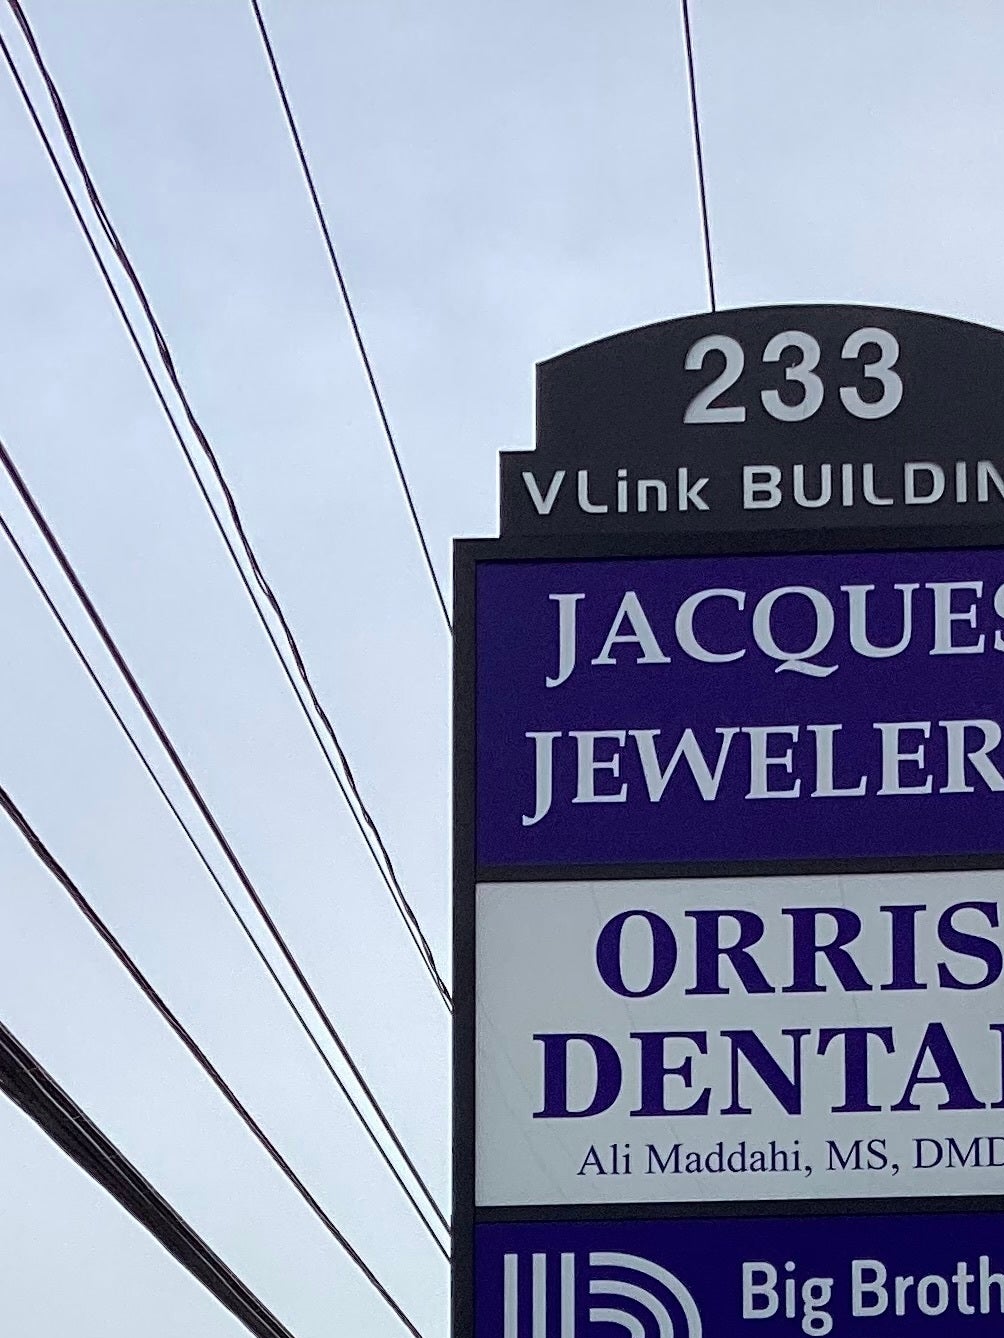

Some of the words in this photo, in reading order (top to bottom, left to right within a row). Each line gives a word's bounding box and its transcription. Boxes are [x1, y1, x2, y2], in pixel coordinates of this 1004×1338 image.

[683, 328, 904, 424] 233
[523, 468, 710, 515] VLink
[595, 901, 1003, 998] ORRIS
[577, 1143, 632, 1176] Ali
[645, 1140, 812, 1178] Maddahi,
[827, 1139, 900, 1176] MS,
[742, 1261, 834, 1336] Big
